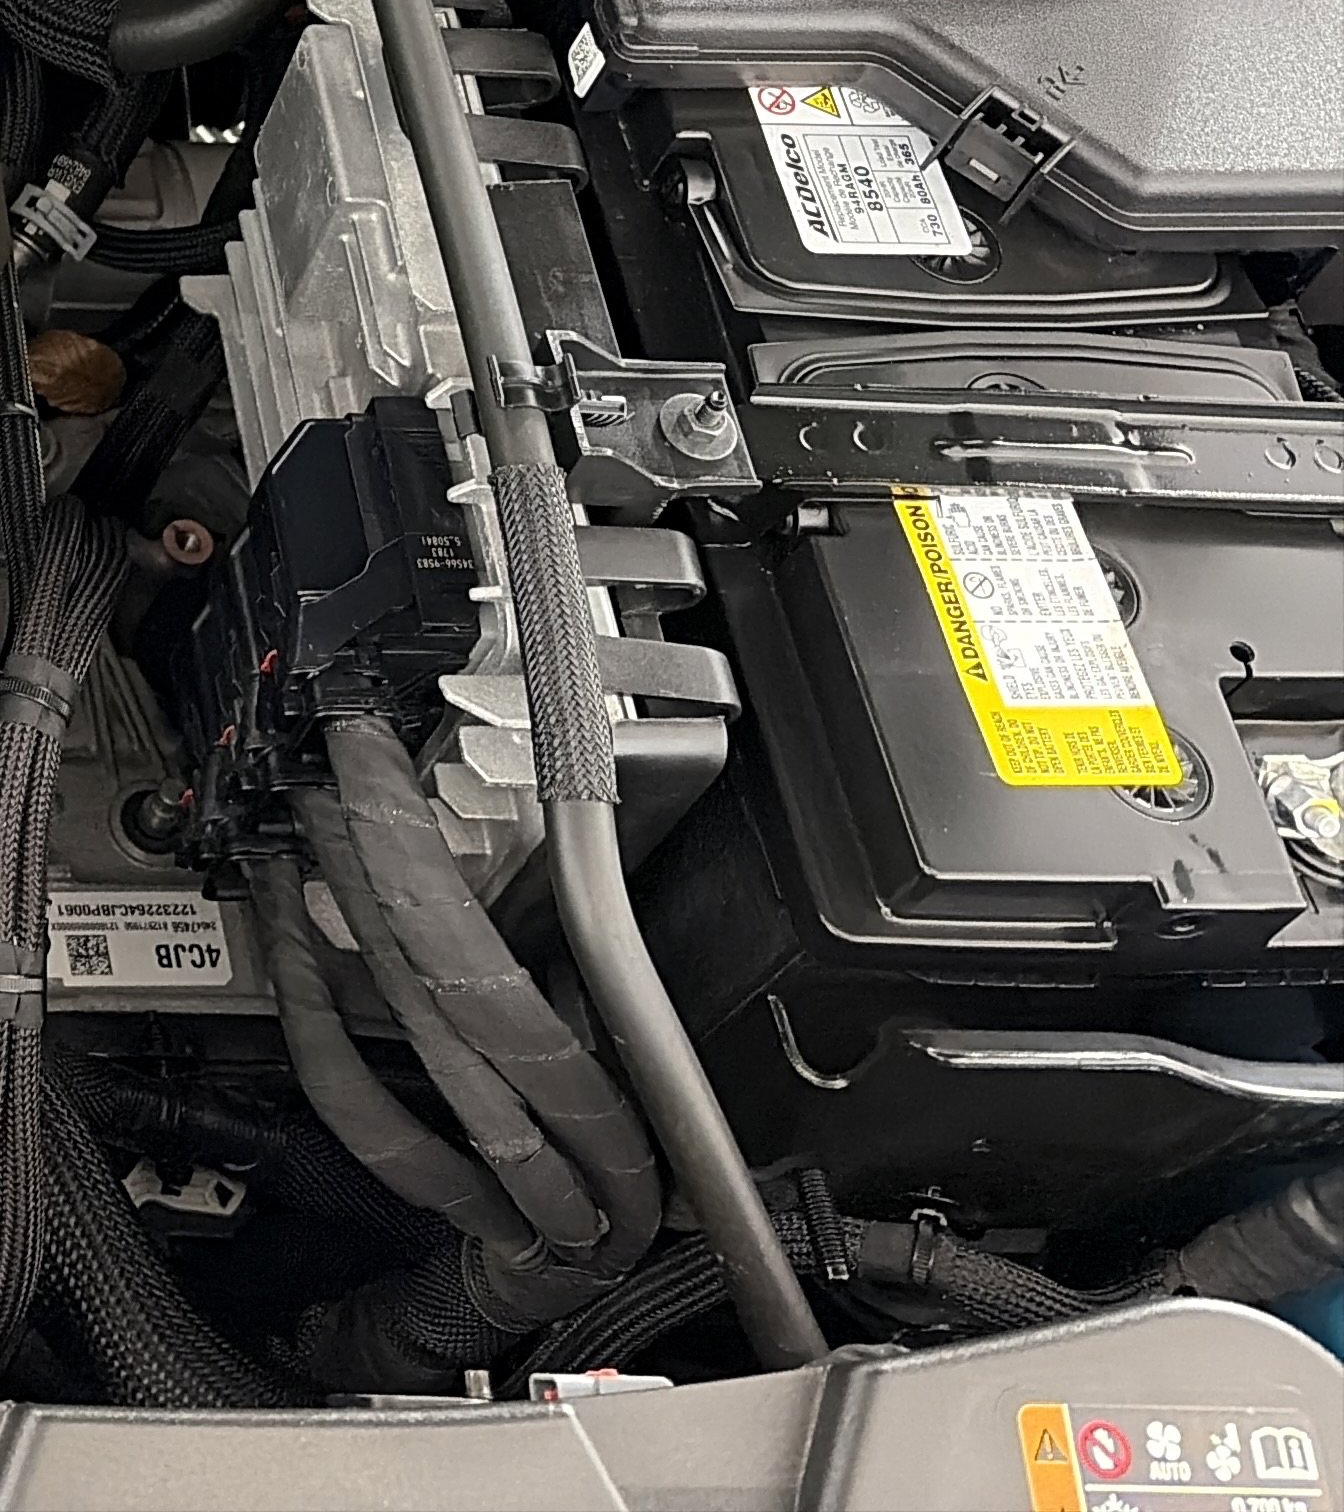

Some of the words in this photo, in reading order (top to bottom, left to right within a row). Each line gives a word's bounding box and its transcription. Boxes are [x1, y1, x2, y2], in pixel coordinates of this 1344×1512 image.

[898, 143, 916, 165] 365
[780, 133, 830, 238] ACDelco
[837, 162, 865, 214] 94RAGM
[852, 165, 884, 211] 8540
[910, 174, 931, 204] 80Ah
[925, 213, 943, 236] 730
[904, 505, 980, 659] DANGER/POISON
[155, 943, 221, 968] 4CJB
[1149, 1460, 1193, 1483] AUTO
